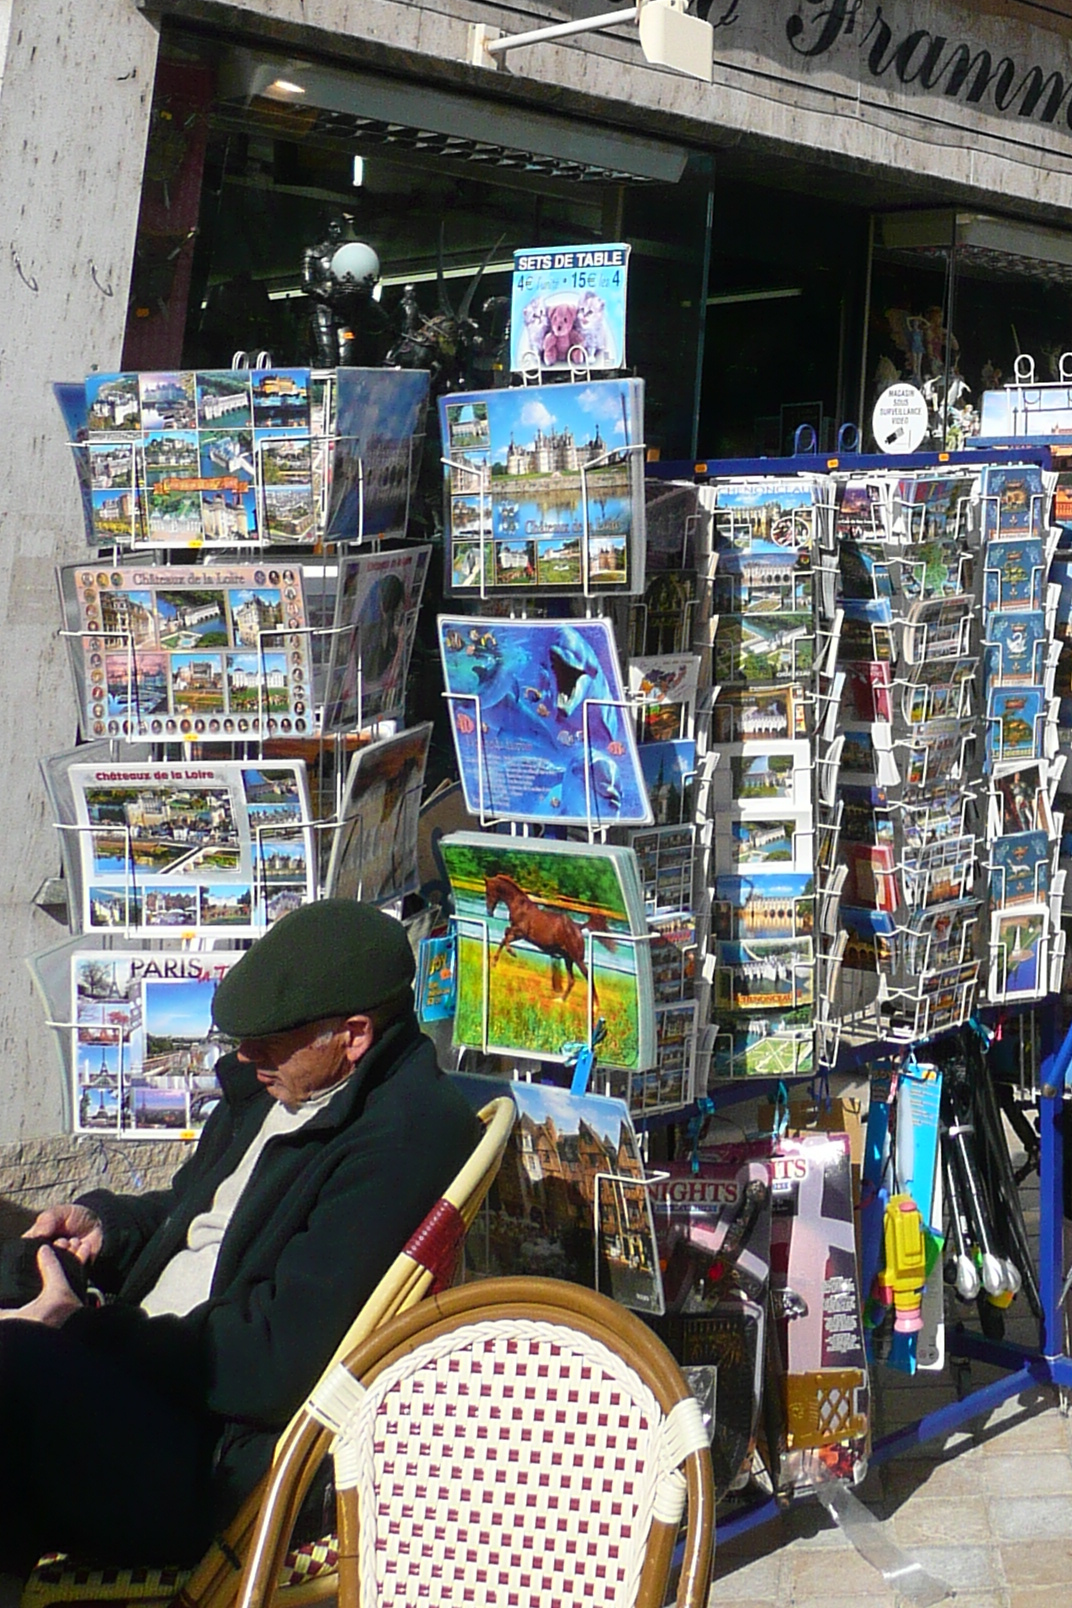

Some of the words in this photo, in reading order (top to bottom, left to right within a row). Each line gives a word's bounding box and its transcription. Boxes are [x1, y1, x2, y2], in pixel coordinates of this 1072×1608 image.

[518, 255, 552, 270] SETS
[554, 254, 573, 268] DE
[576, 251, 622, 266] TABLE
[518, 275, 533, 291] 4€
[571, 272, 597, 288] 15€
[612, 270, 620, 287] 4
[187, 572, 200, 585] de
[203, 572, 214, 585] la
[216, 572, 246, 585] Loire
[96, 771, 151, 781] Châteaux
[154, 771, 168, 780] de
[171, 771, 182, 780] la
[185, 770, 215, 780] Loire
[131, 957, 202, 979] PARIS
[647, 1182, 738, 1203] NIGHTS
